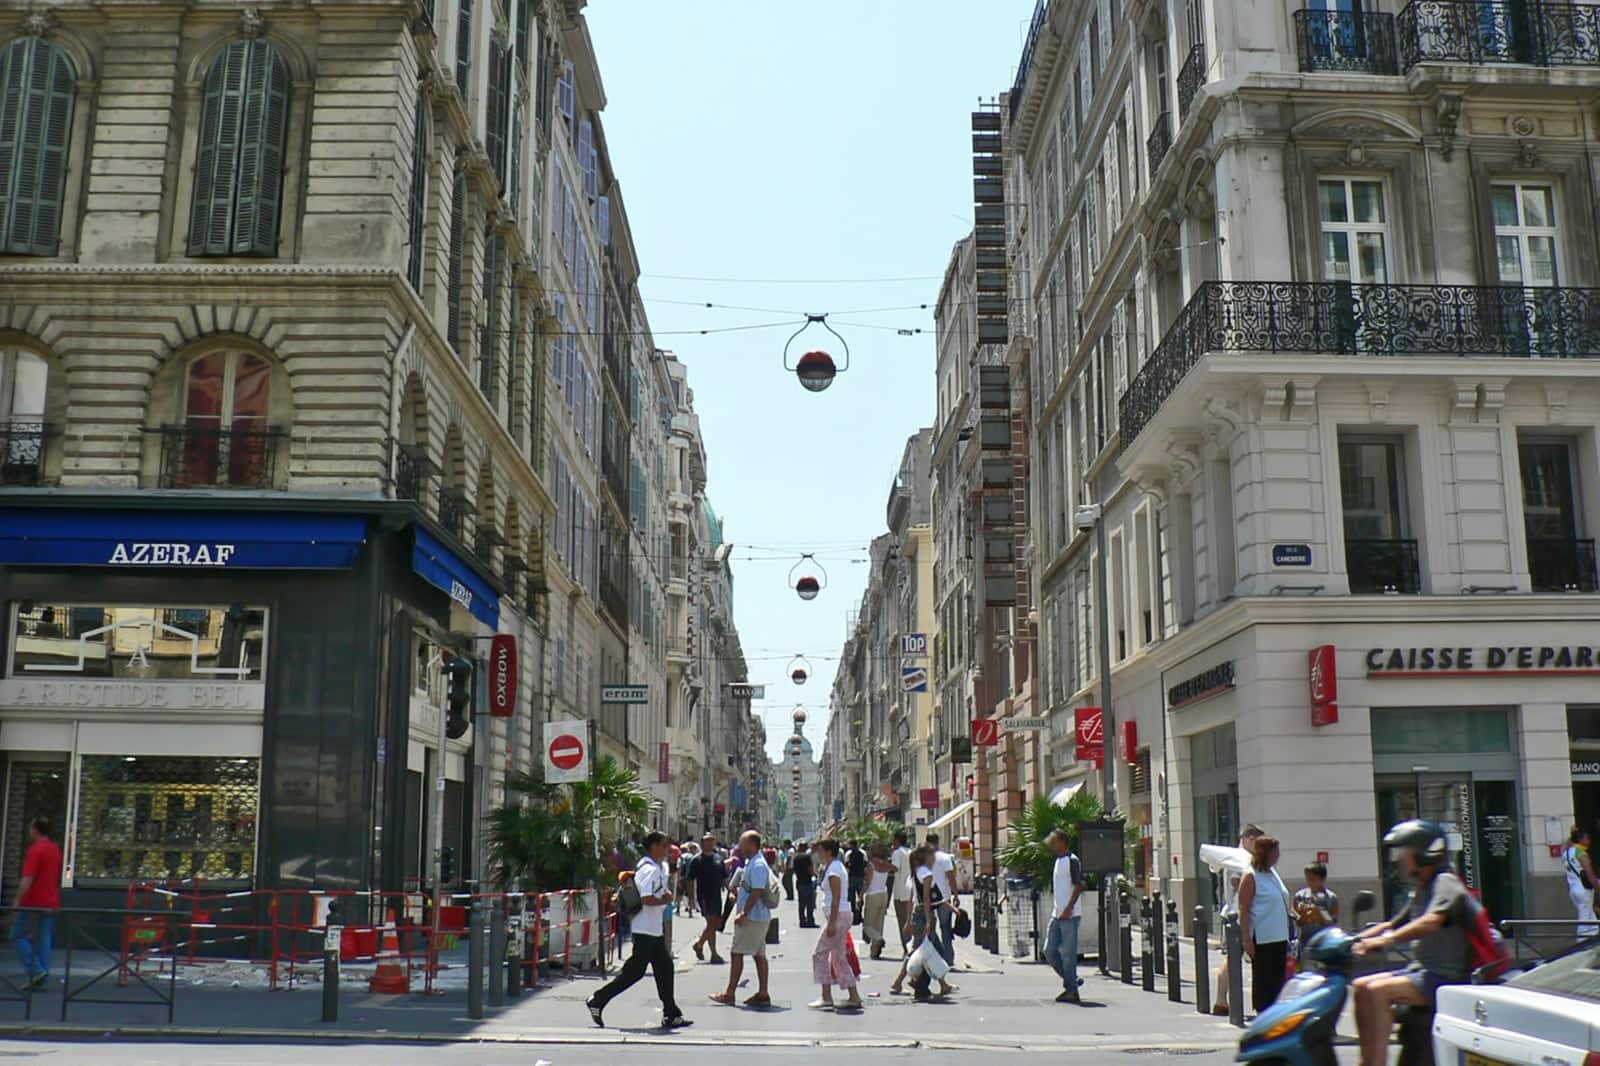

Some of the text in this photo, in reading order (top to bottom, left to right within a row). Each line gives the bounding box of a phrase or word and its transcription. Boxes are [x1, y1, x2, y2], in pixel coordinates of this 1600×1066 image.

[108, 543, 235, 566] AZERAF
[902, 635, 925, 652] TOP
[1366, 647, 1600, 670] CAISSE D'EPAR
[496, 643, 509, 707] OXBOW
[16, 682, 169, 708] ARISTIDE
